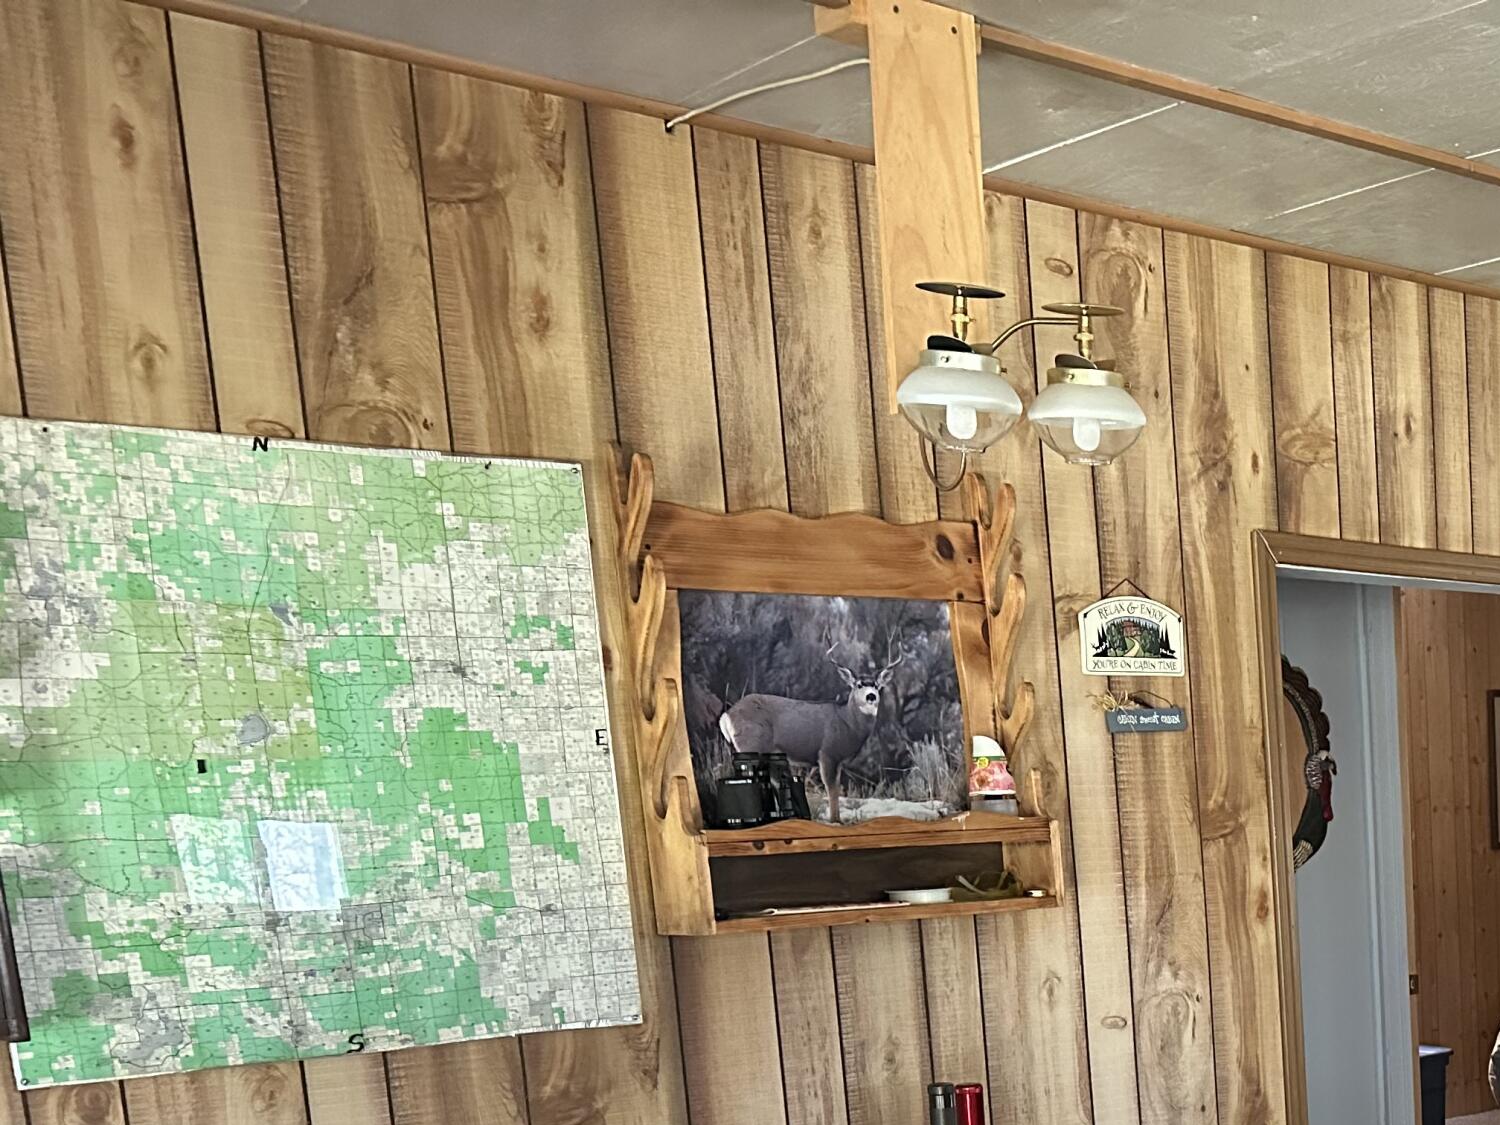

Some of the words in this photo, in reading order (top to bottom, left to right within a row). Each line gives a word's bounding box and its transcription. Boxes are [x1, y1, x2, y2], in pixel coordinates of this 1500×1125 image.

[252, 436, 268, 452] N
[1097, 602, 1125, 620] RELAX
[1127, 601, 1139, 615] &
[1140, 603, 1168, 623] ENJOY
[1093, 659, 1118, 670] YOU'RE
[1120, 660, 1131, 670] ON
[1133, 660, 1156, 671] CABIN
[1158, 660, 1177, 671] TIME
[595, 728, 608, 746] E
[346, 1033, 364, 1054] S
